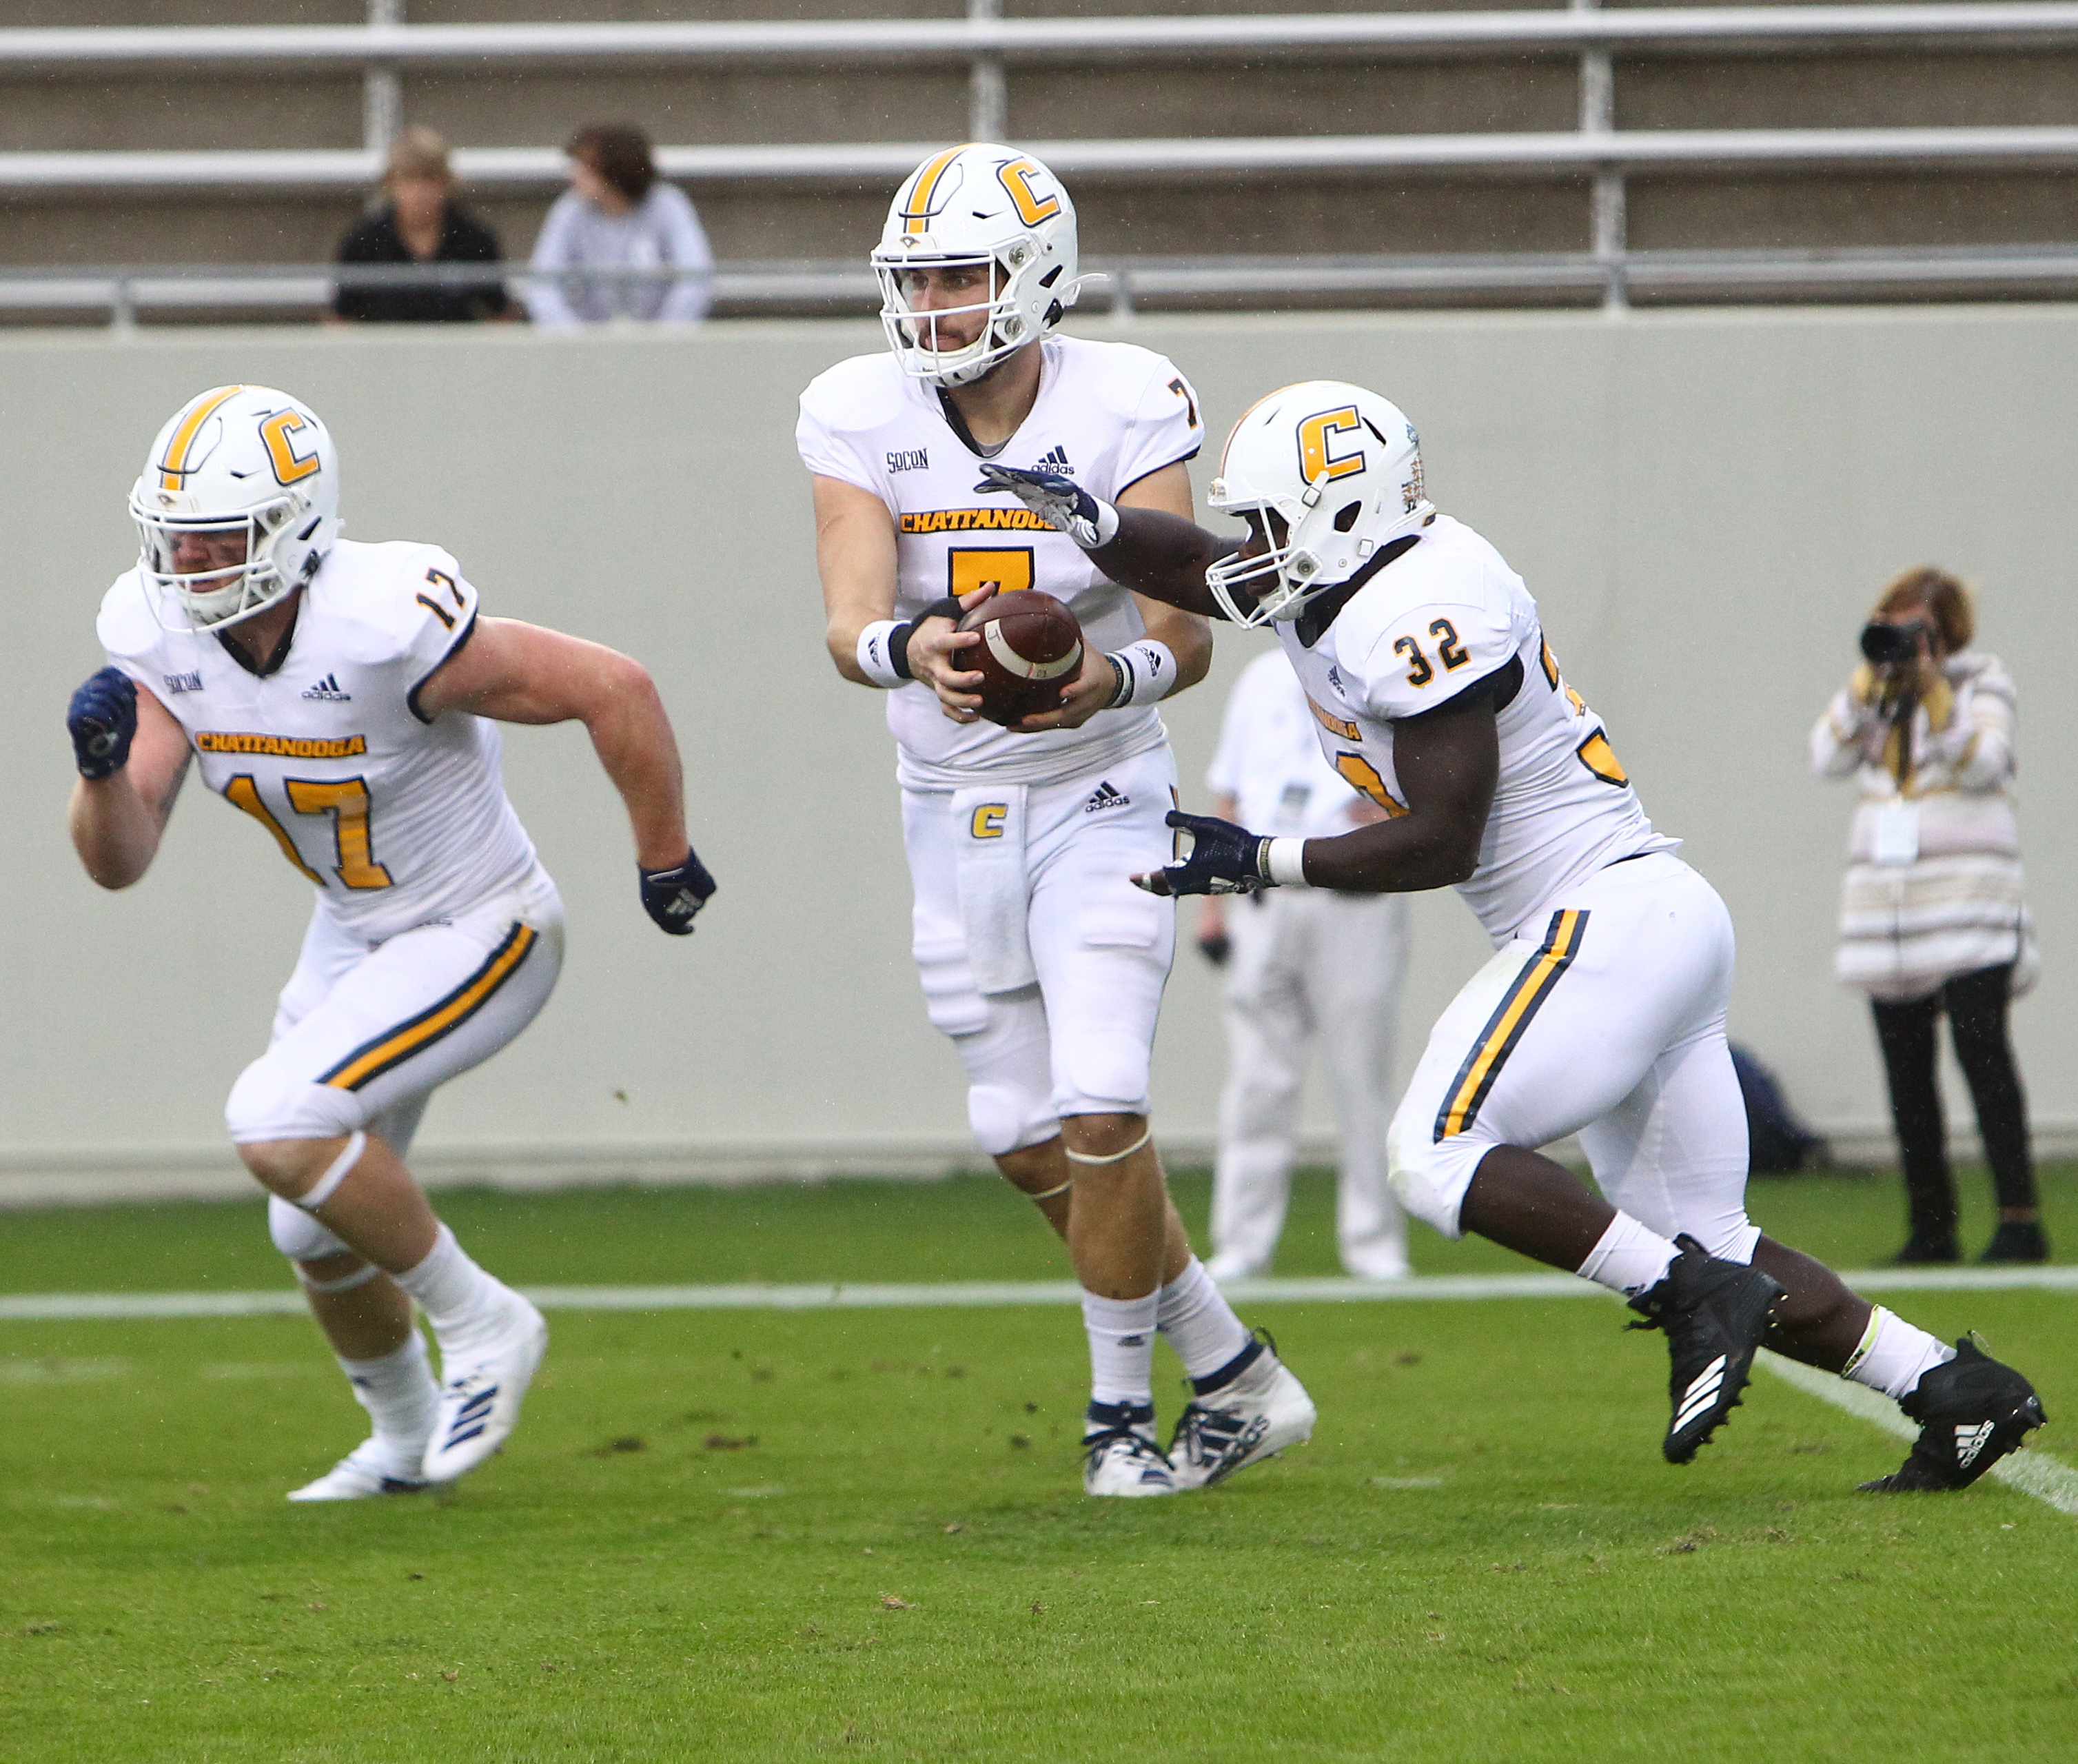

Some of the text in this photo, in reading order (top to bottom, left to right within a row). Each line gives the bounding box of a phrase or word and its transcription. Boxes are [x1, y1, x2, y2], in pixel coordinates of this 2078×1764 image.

[995, 156, 1062, 228] C
[1166, 376, 1198, 430] 7
[258, 406, 321, 487] C
[1032, 463, 1074, 475] adidas
[1296, 404, 1366, 487] C
[416, 567, 465, 631] 17
[1392, 616, 1471, 689] 32
[195, 731, 366, 758] CHATTANOOGA
[222, 772, 394, 889] 17
[970, 803, 1008, 839] C
[1086, 795, 1130, 813] adidas
[1959, 1419, 1995, 1469] adidas
